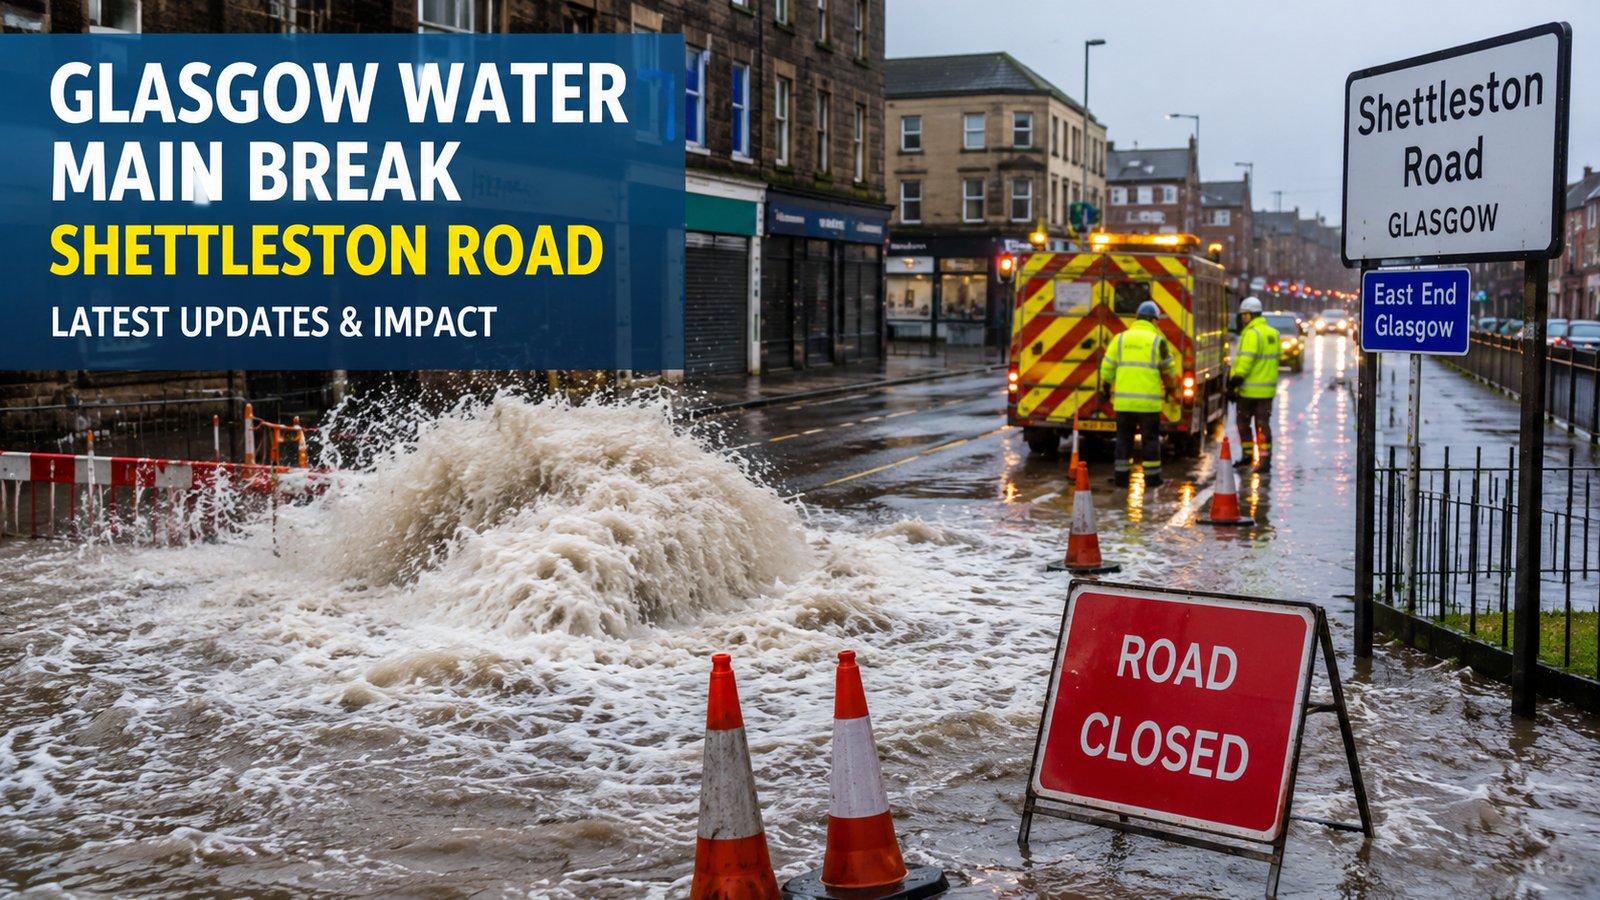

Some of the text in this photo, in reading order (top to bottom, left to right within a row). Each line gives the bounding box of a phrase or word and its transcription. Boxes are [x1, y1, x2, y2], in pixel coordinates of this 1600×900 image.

[1357, 71, 1544, 136] Shettleston
[1403, 135, 1484, 188] Road
[1388, 202, 1499, 239] GLASGOW
[1374, 281, 1457, 306] East End
[1375, 313, 1454, 343] Glasgow
[1116, 634, 1238, 691] ROAD
[1080, 712, 1249, 781] CLOSED
